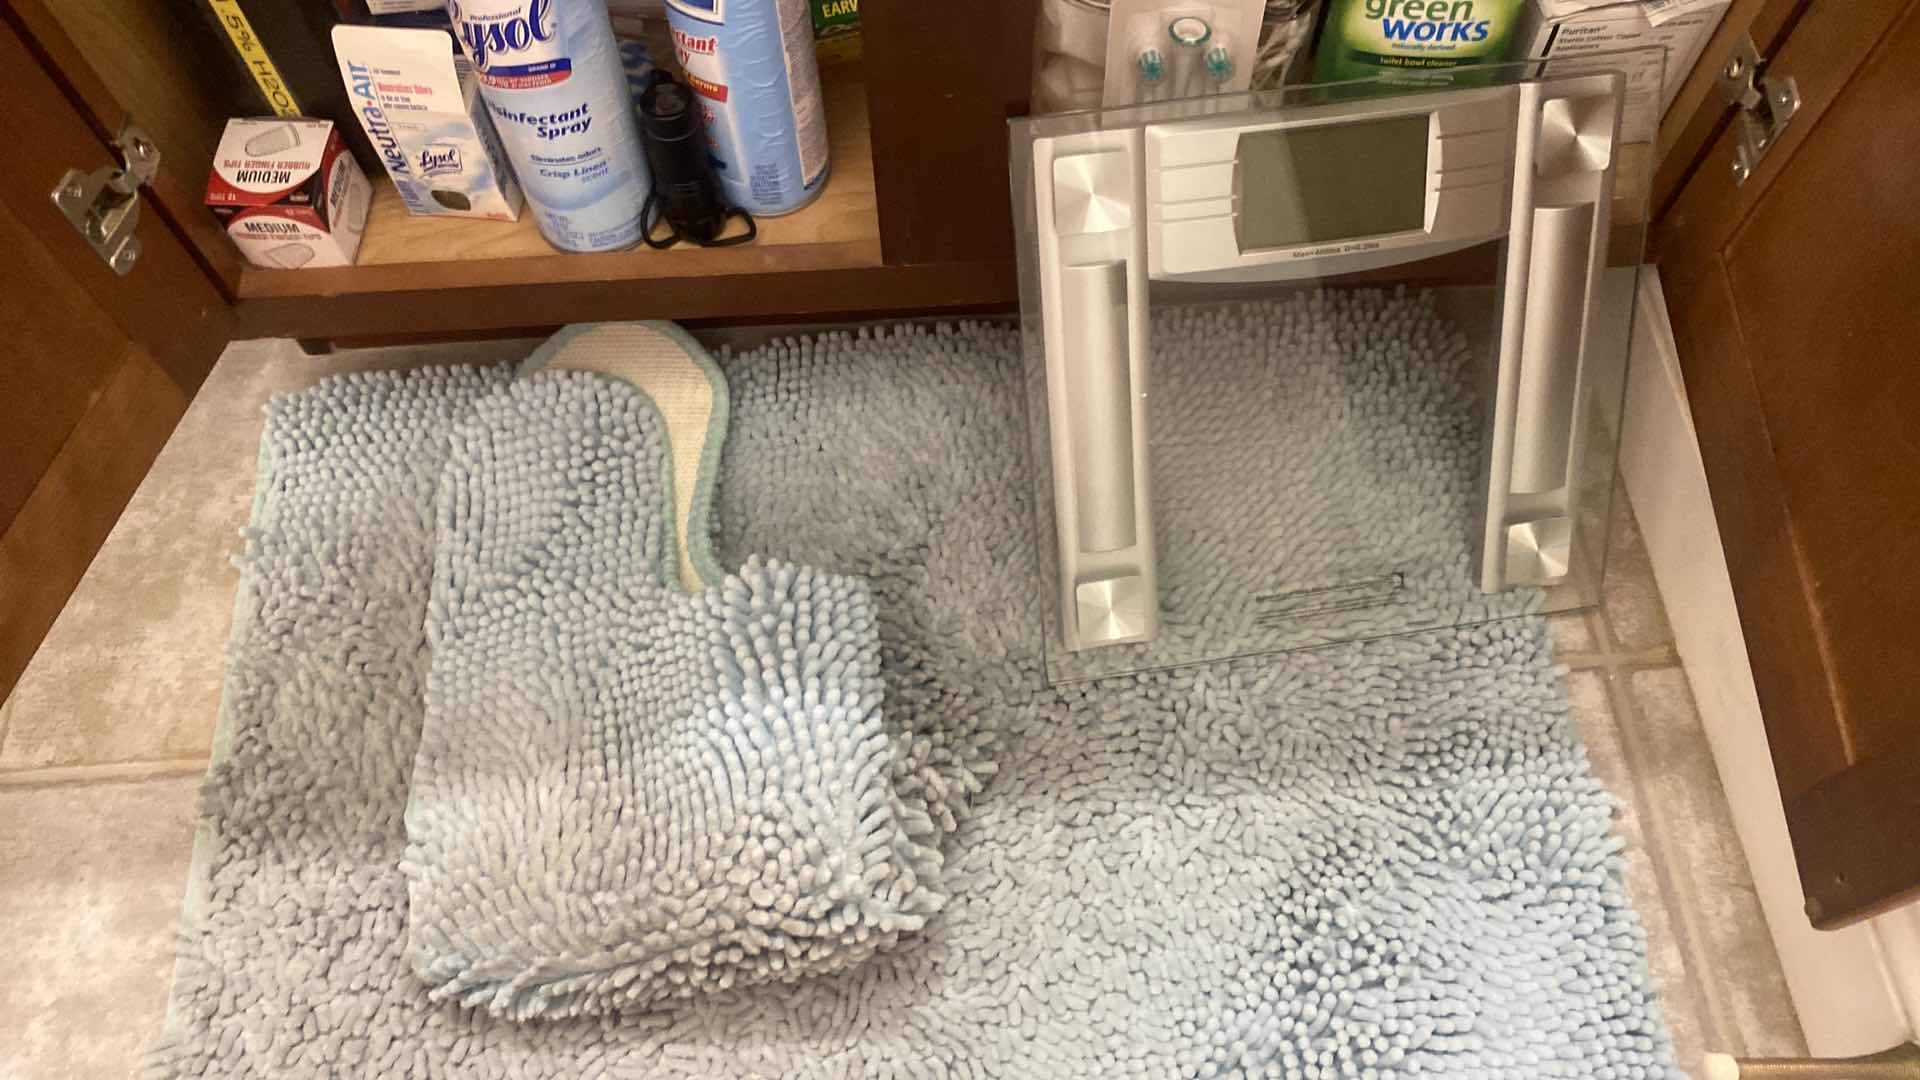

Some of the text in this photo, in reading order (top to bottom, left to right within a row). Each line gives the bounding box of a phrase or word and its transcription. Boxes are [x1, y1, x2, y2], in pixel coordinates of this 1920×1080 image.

[1365, 0, 1474, 21] green
[537, 116, 593, 140] Spray
[223, 159, 243, 169] TIPS
[243, 159, 277, 170] FINGER
[420, 149, 459, 172] Lysol
[236, 170, 291, 184] MEDIUM
[540, 161, 607, 180] Crisp Linen
[244, 221, 301, 234] MEDIUM
